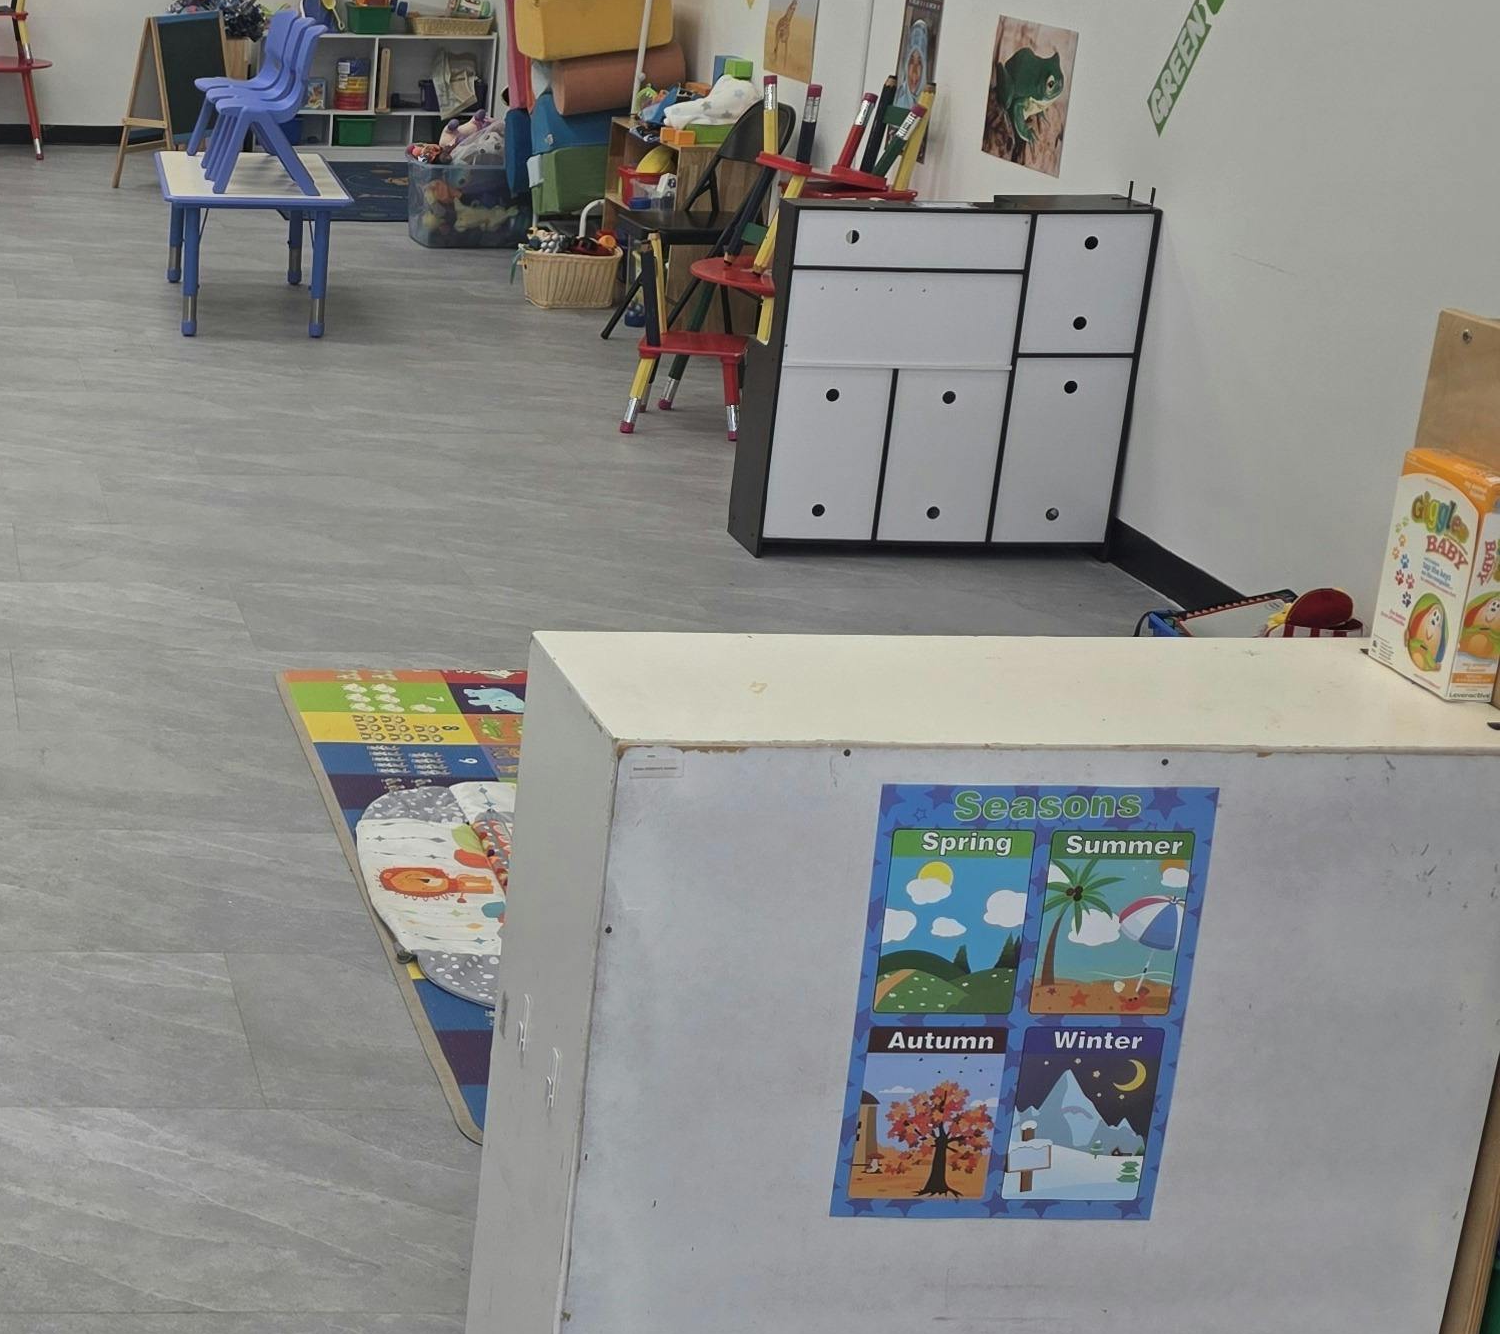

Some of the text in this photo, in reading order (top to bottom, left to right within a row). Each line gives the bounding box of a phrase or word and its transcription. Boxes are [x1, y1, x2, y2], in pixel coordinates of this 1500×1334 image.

[1150, 3, 1207, 125] GREEN
[1425, 534, 1469, 571] BABY
[1477, 539, 1498, 587] BABY
[953, 790, 1143, 822] Seasons
[922, 831, 1184, 857] Spring Summer
[887, 1030, 1144, 1051] Autumn Winter
